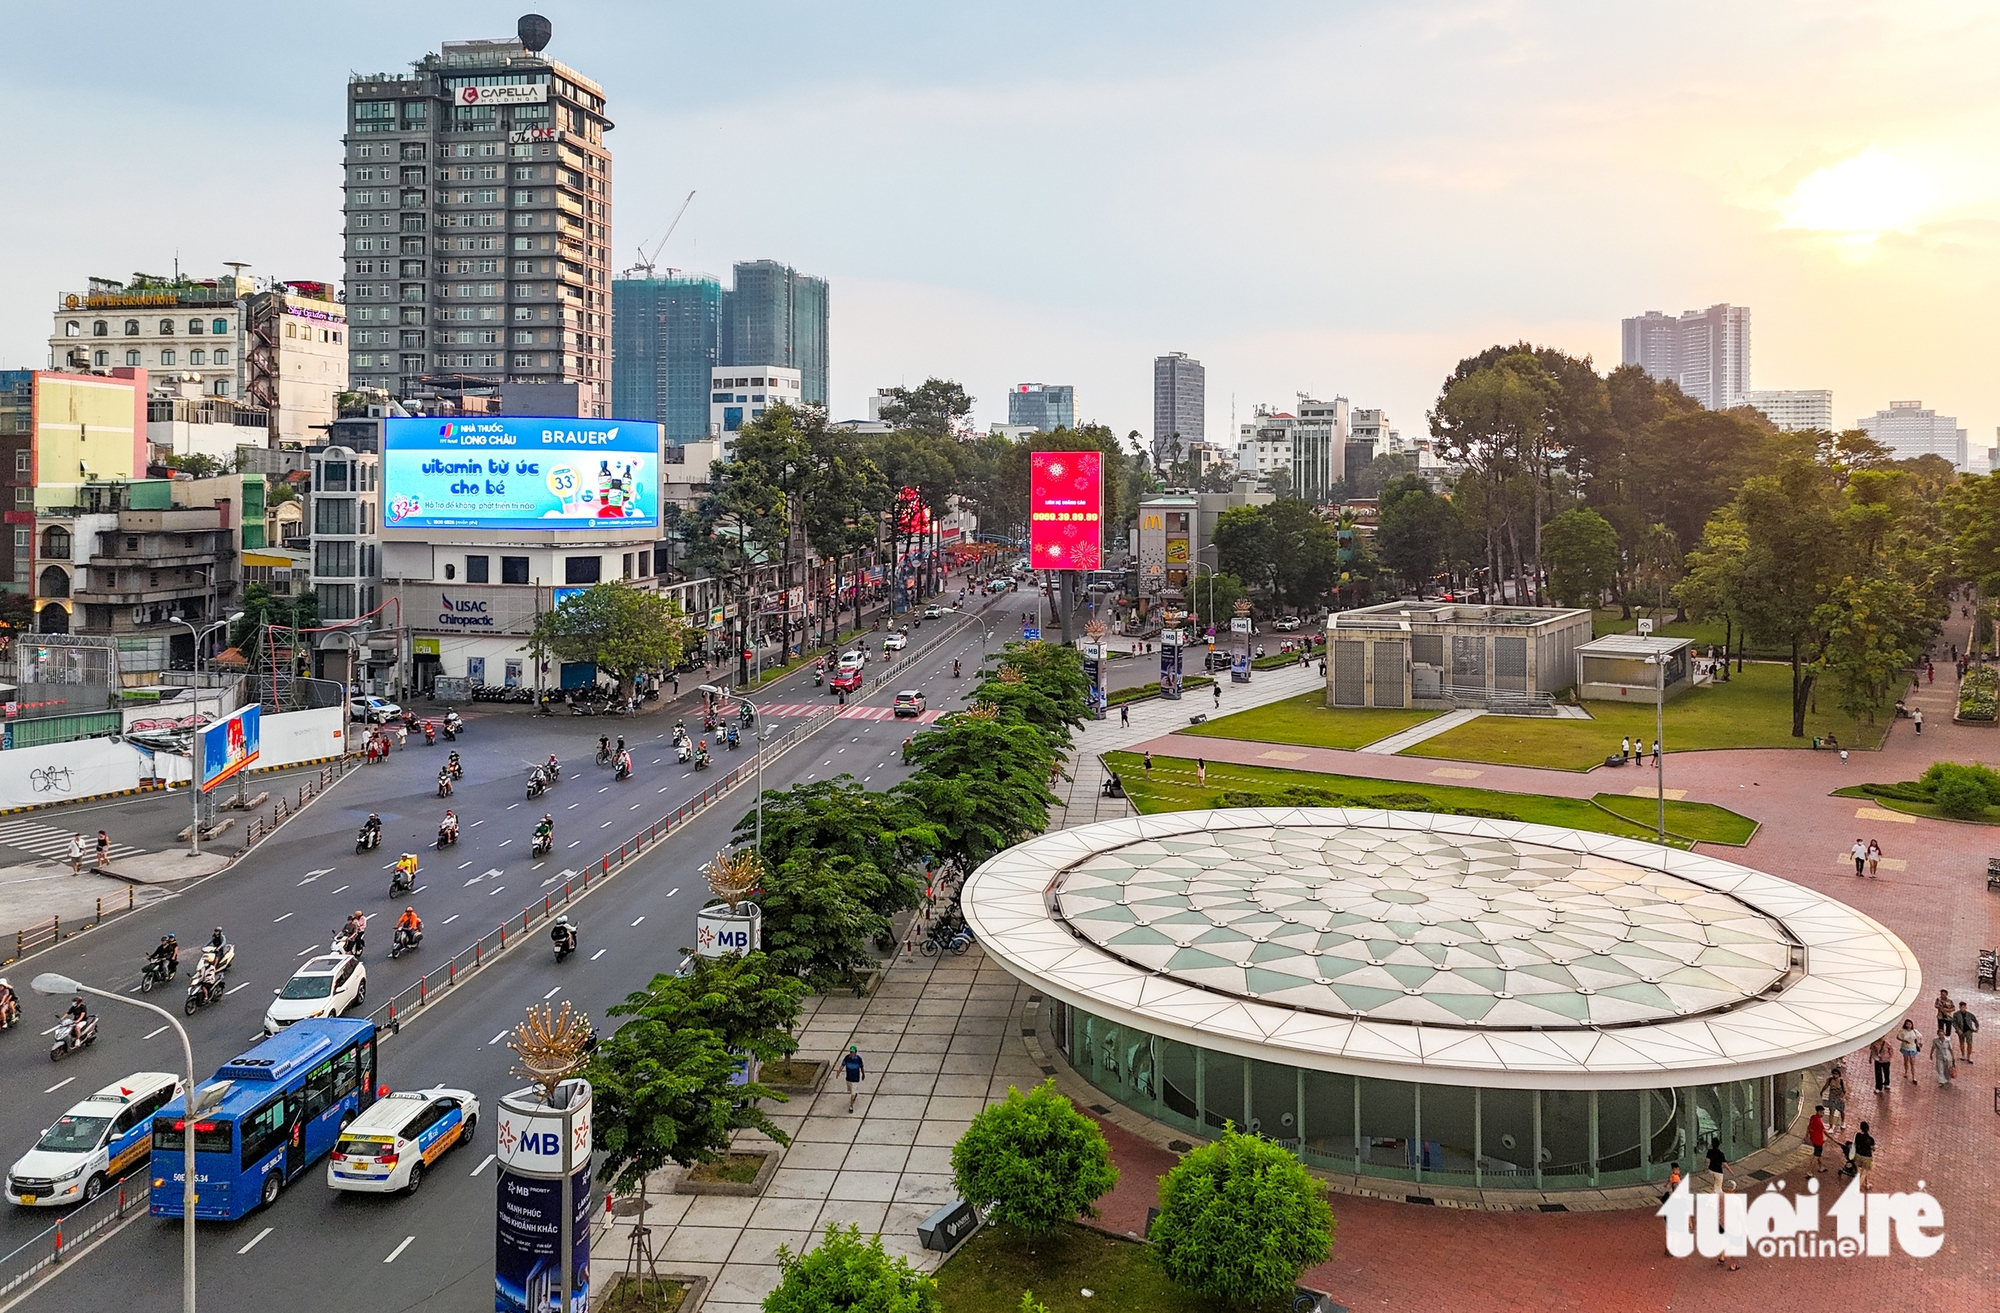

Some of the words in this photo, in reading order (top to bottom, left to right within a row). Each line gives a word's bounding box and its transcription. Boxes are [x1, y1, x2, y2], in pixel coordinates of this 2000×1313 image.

[481, 87, 538, 98] CAPELLA
[531, 128, 555, 139] ONE
[122, 294, 151, 305] GRAND
[152, 294, 177, 305] HOTEL
[288, 304, 302, 317] Sky
[303, 307, 326, 320] Garden
[461, 423, 476, 432] NHÀ
[478, 422, 503, 432] THUỐC
[461, 436, 487, 445] LONG
[489, 433, 516, 445] CHÂU
[542, 430, 607, 444] BRAUER
[422, 458, 482, 474] vitamin
[488, 458, 509, 474] từ
[516, 460, 539, 474] úc
[451, 479, 480, 494] cho
[486, 479, 505, 494] bé
[1033, 513, 1098, 521] 0969.39.89.89
[456, 601, 487, 612] USAC
[439, 614, 493, 627] Chiropractic
[718, 932, 747, 946] MB
[520, 1131, 560, 1155] MB
[516, 1185, 529, 1196] MB
[523, 1208, 542, 1218] PHÚC
[511, 1218, 536, 1232] KHOẢNH
[537, 1222, 558, 1233] KHẮC
